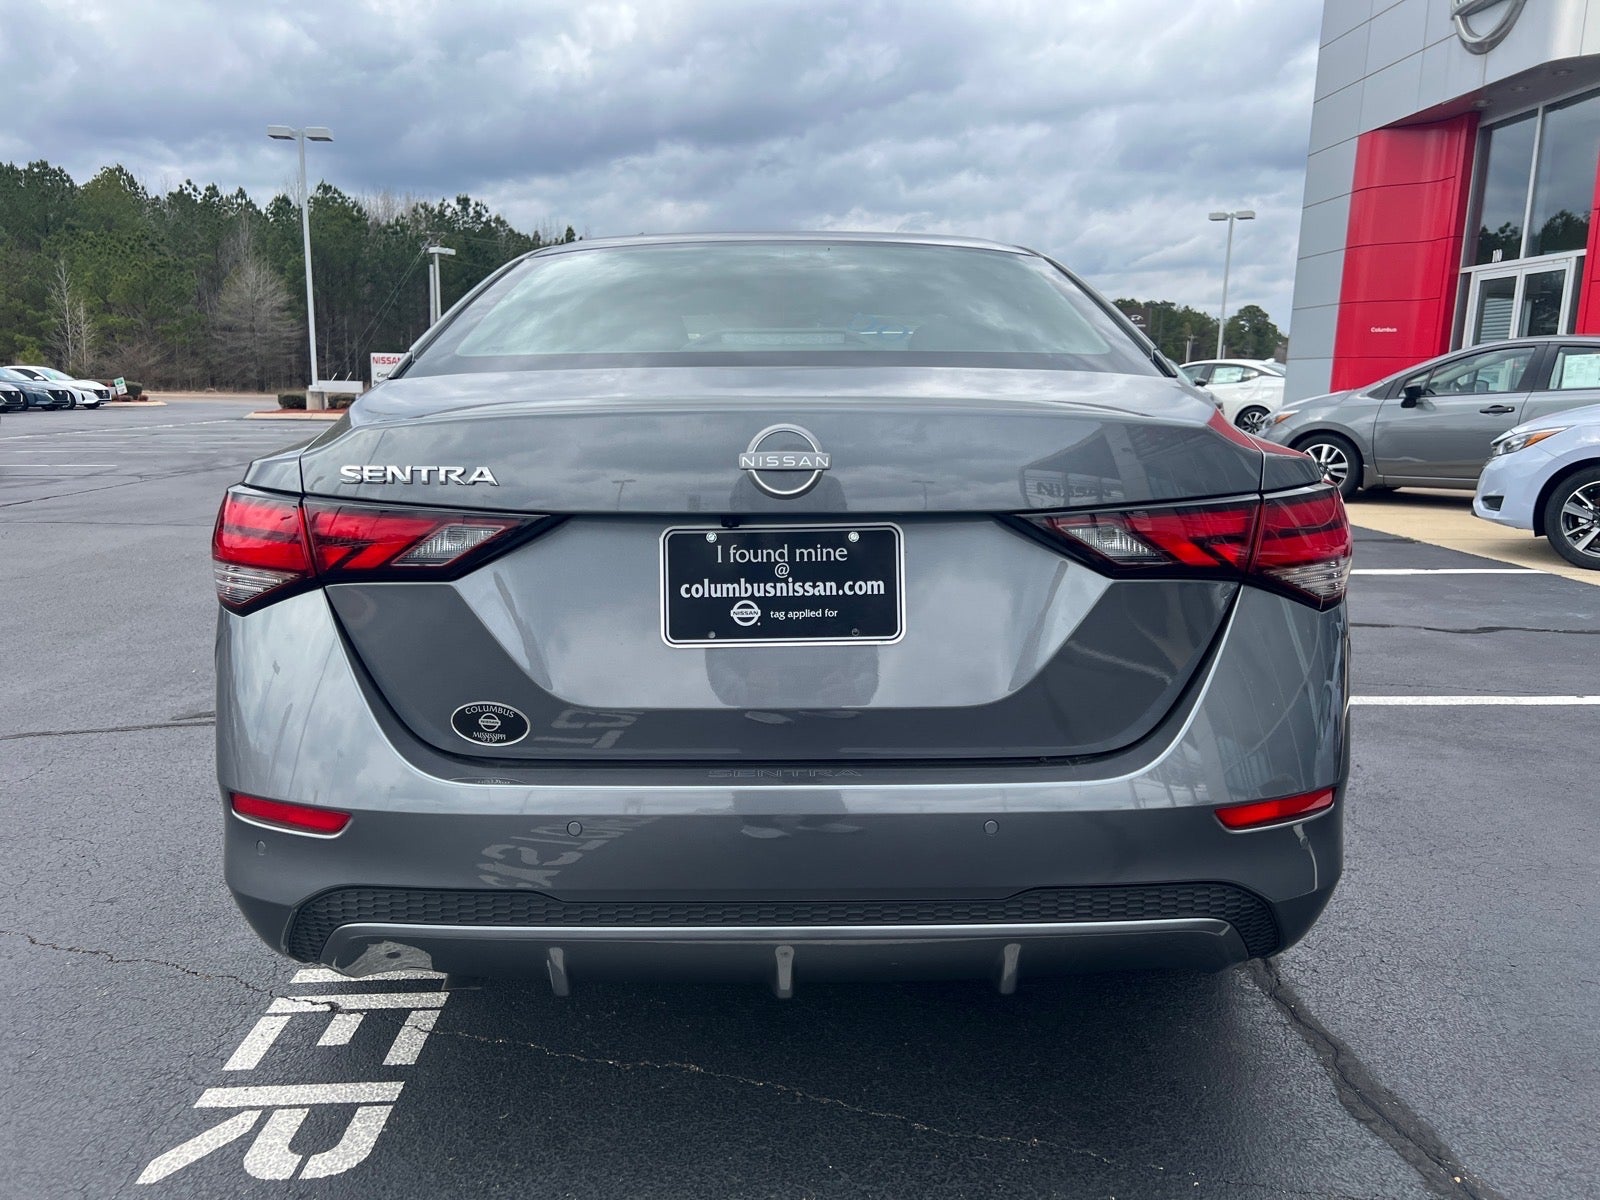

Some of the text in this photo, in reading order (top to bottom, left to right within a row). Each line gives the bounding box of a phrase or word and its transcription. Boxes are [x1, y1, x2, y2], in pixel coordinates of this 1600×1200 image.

[741, 455, 829, 467] NISSAN
[340, 465, 500, 486] SENTRA
[716, 544, 848, 563] I found mine
[774, 562, 790, 578] @
[680, 575, 885, 599] columbusnissan.com
[770, 608, 839, 620] tag applied for
[465, 705, 515, 718] COLUMBUS
[472, 731, 506, 743] MISSISSIPPI
[707, 768, 863, 778] SENTRA
